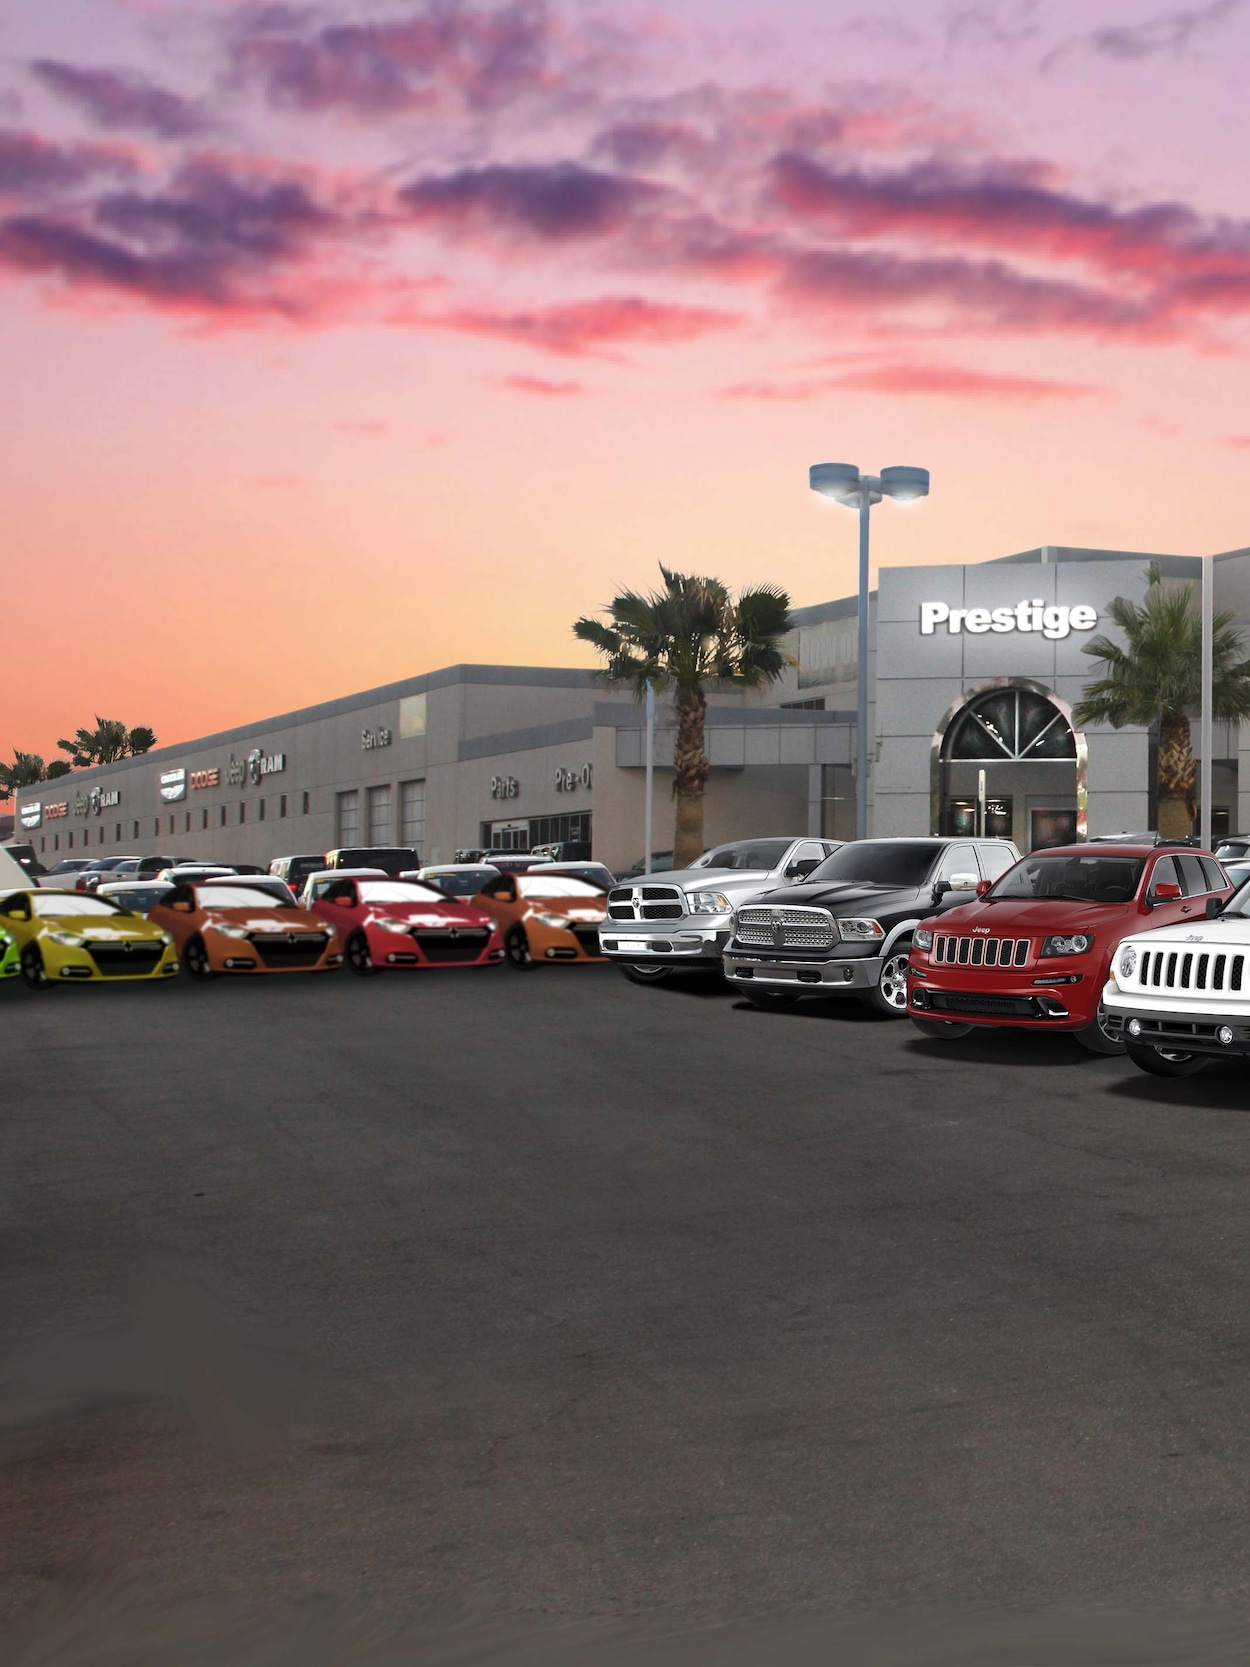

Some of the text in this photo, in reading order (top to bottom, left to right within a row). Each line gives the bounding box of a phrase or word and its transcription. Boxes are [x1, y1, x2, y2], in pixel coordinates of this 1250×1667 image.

[921, 598, 1098, 639] Prestige
[361, 727, 390, 750] Service
[261, 754, 283, 774] RAM
[491, 775, 517, 799] Parts
[100, 791, 119, 807] RAM
[972, 926, 991, 935] Jeep
